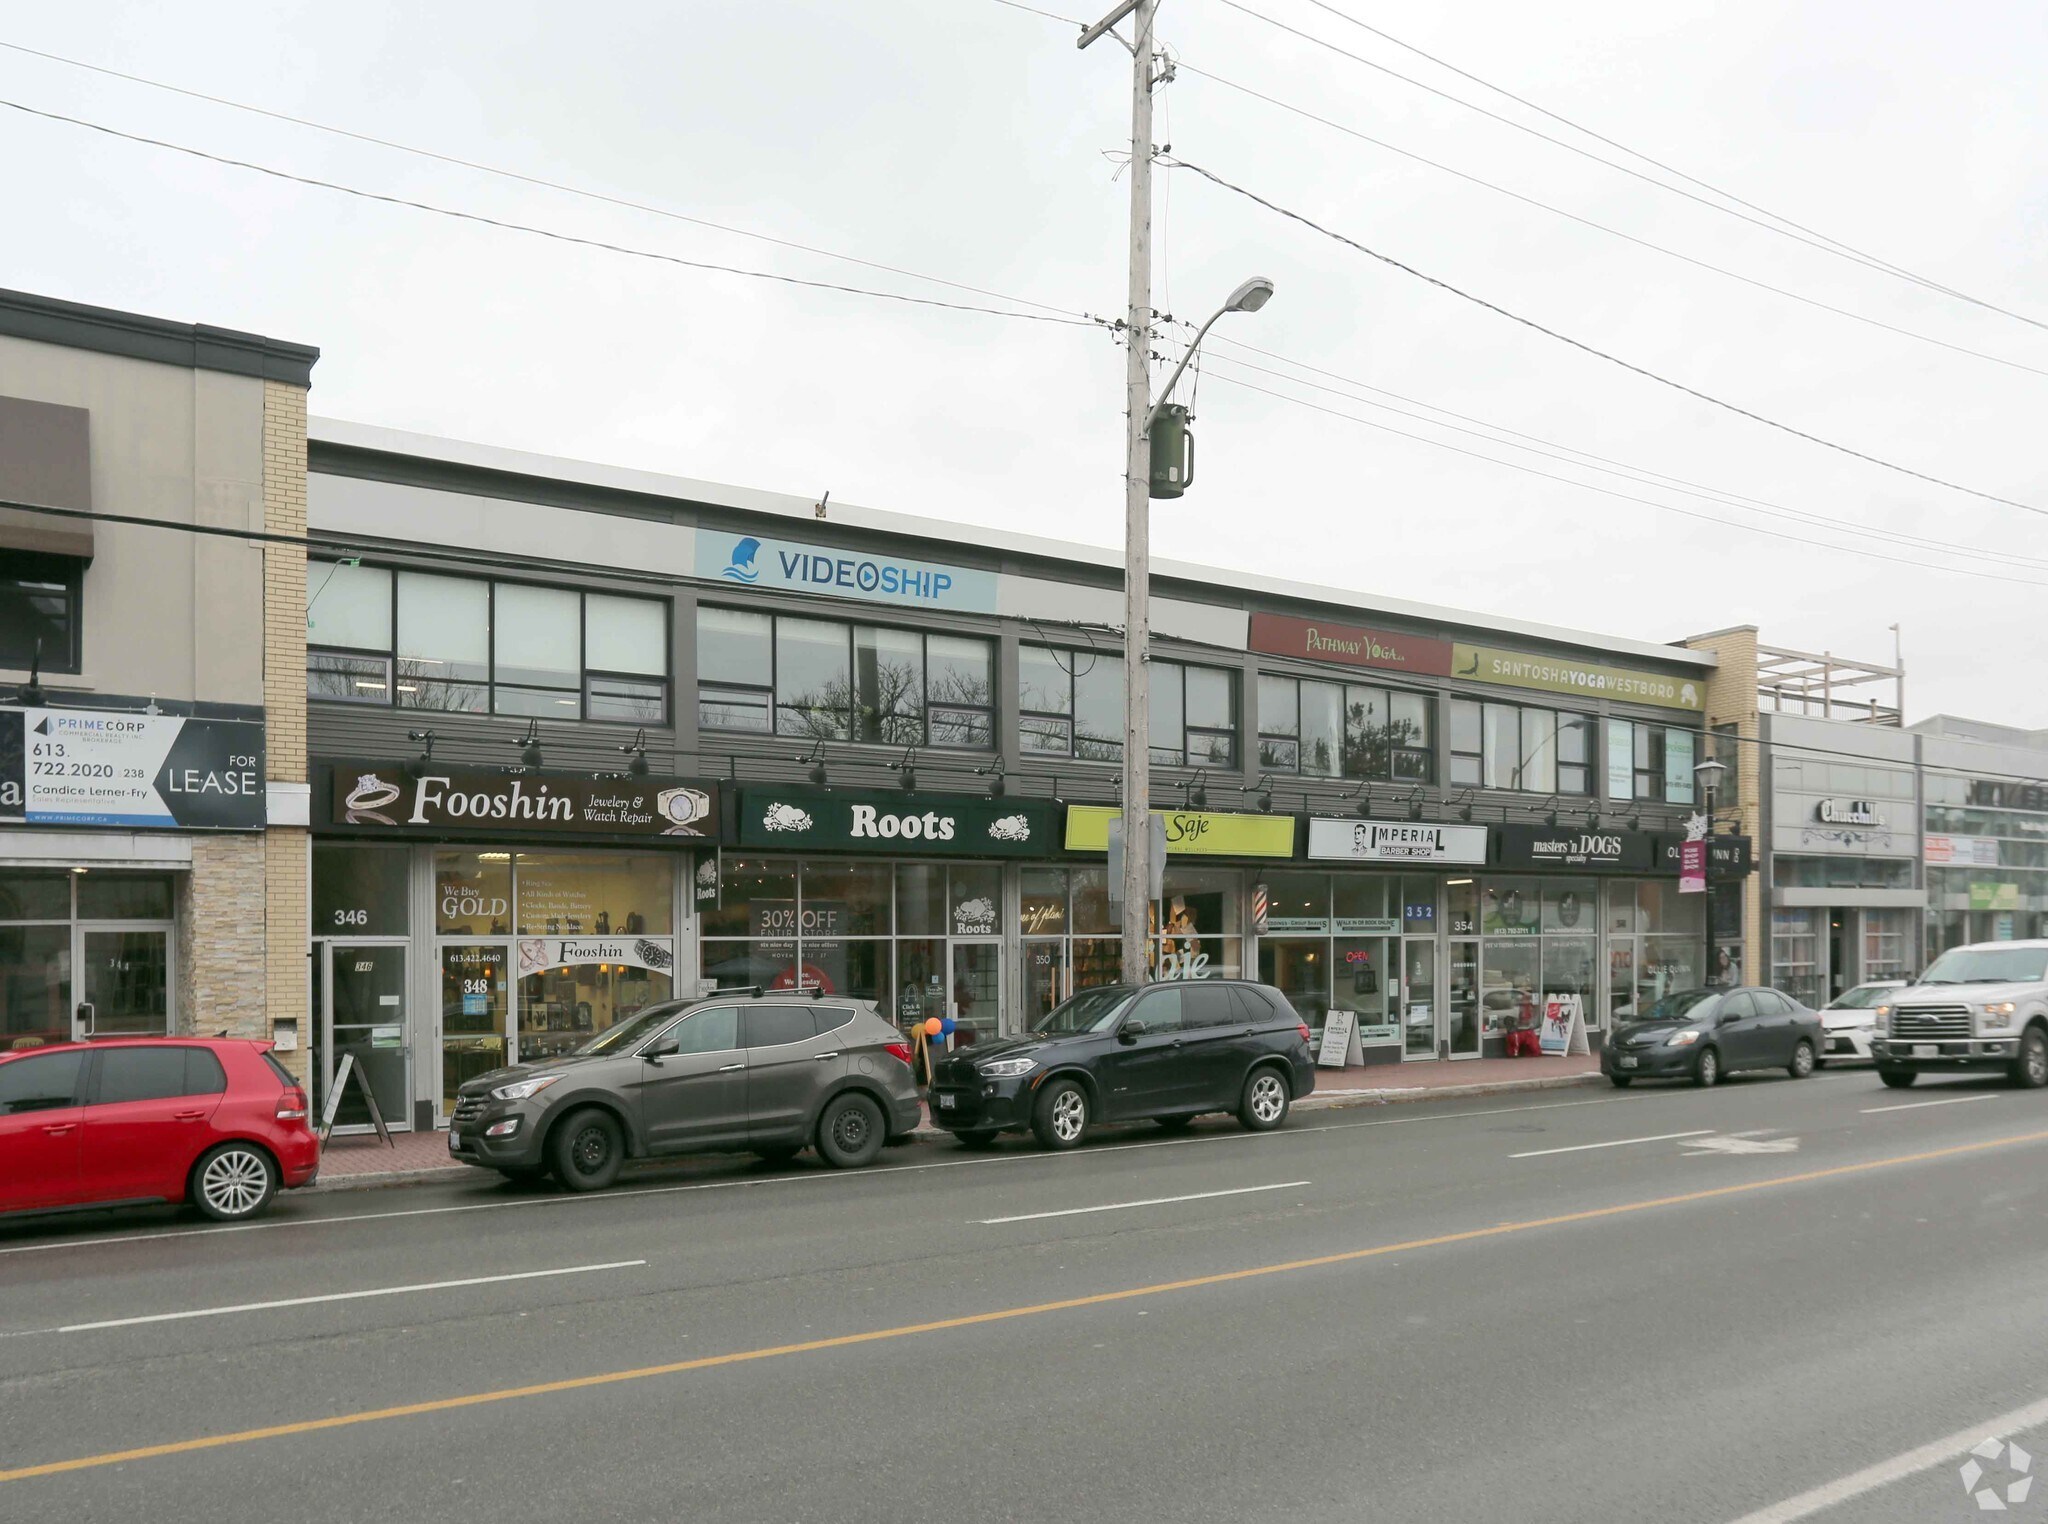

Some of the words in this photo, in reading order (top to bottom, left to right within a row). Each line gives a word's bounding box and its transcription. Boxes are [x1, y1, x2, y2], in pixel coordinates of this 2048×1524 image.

[778, 551, 952, 599] VIDEOSHIP
[1306, 628, 1361, 655] PATHWAY
[58, 718, 145, 732] PRIMECORP
[33, 743, 70, 758] 613.
[229, 755, 256, 767] FOR
[33, 762, 113, 777] 722.2020
[169, 769, 256, 795] LEASE
[33, 785, 85, 795] Candice
[90, 786, 147, 799] Lerner-Fry
[407, 777, 574, 823] Fooshin
[589, 794, 629, 810] Jewelery
[633, 796, 644, 809] &
[584, 809, 616, 822] Watch
[620, 810, 652, 825] Repair
[850, 804, 955, 840] Roots
[1166, 815, 1209, 842] Saje
[1371, 826, 1445, 851] IMPERIAL
[1533, 839, 1567, 853] masters
[1579, 835, 1622, 855] DOGS
[1381, 847, 1409, 855] BARBER
[1411, 848, 1431, 856] SHOP
[444, 885, 458, 896] We
[461, 887, 480, 898] Buy
[697, 887, 716, 900] Roots
[442, 898, 507, 919] GOLD
[1407, 907, 1432, 917] 352
[334, 909, 367, 925] 346
[761, 910, 794, 928] 30%
[802, 911, 837, 928] OFF
[957, 923, 992, 934] Roots
[1454, 921, 1473, 931] 354
[450, 954, 501, 963] 613.422.4640
[558, 941, 623, 963] Fooshin
[1036, 955, 1050, 964] 350
[1346, 951, 1369, 962] OPEN
[110, 958, 129, 971] 344
[464, 979, 488, 994] 348
